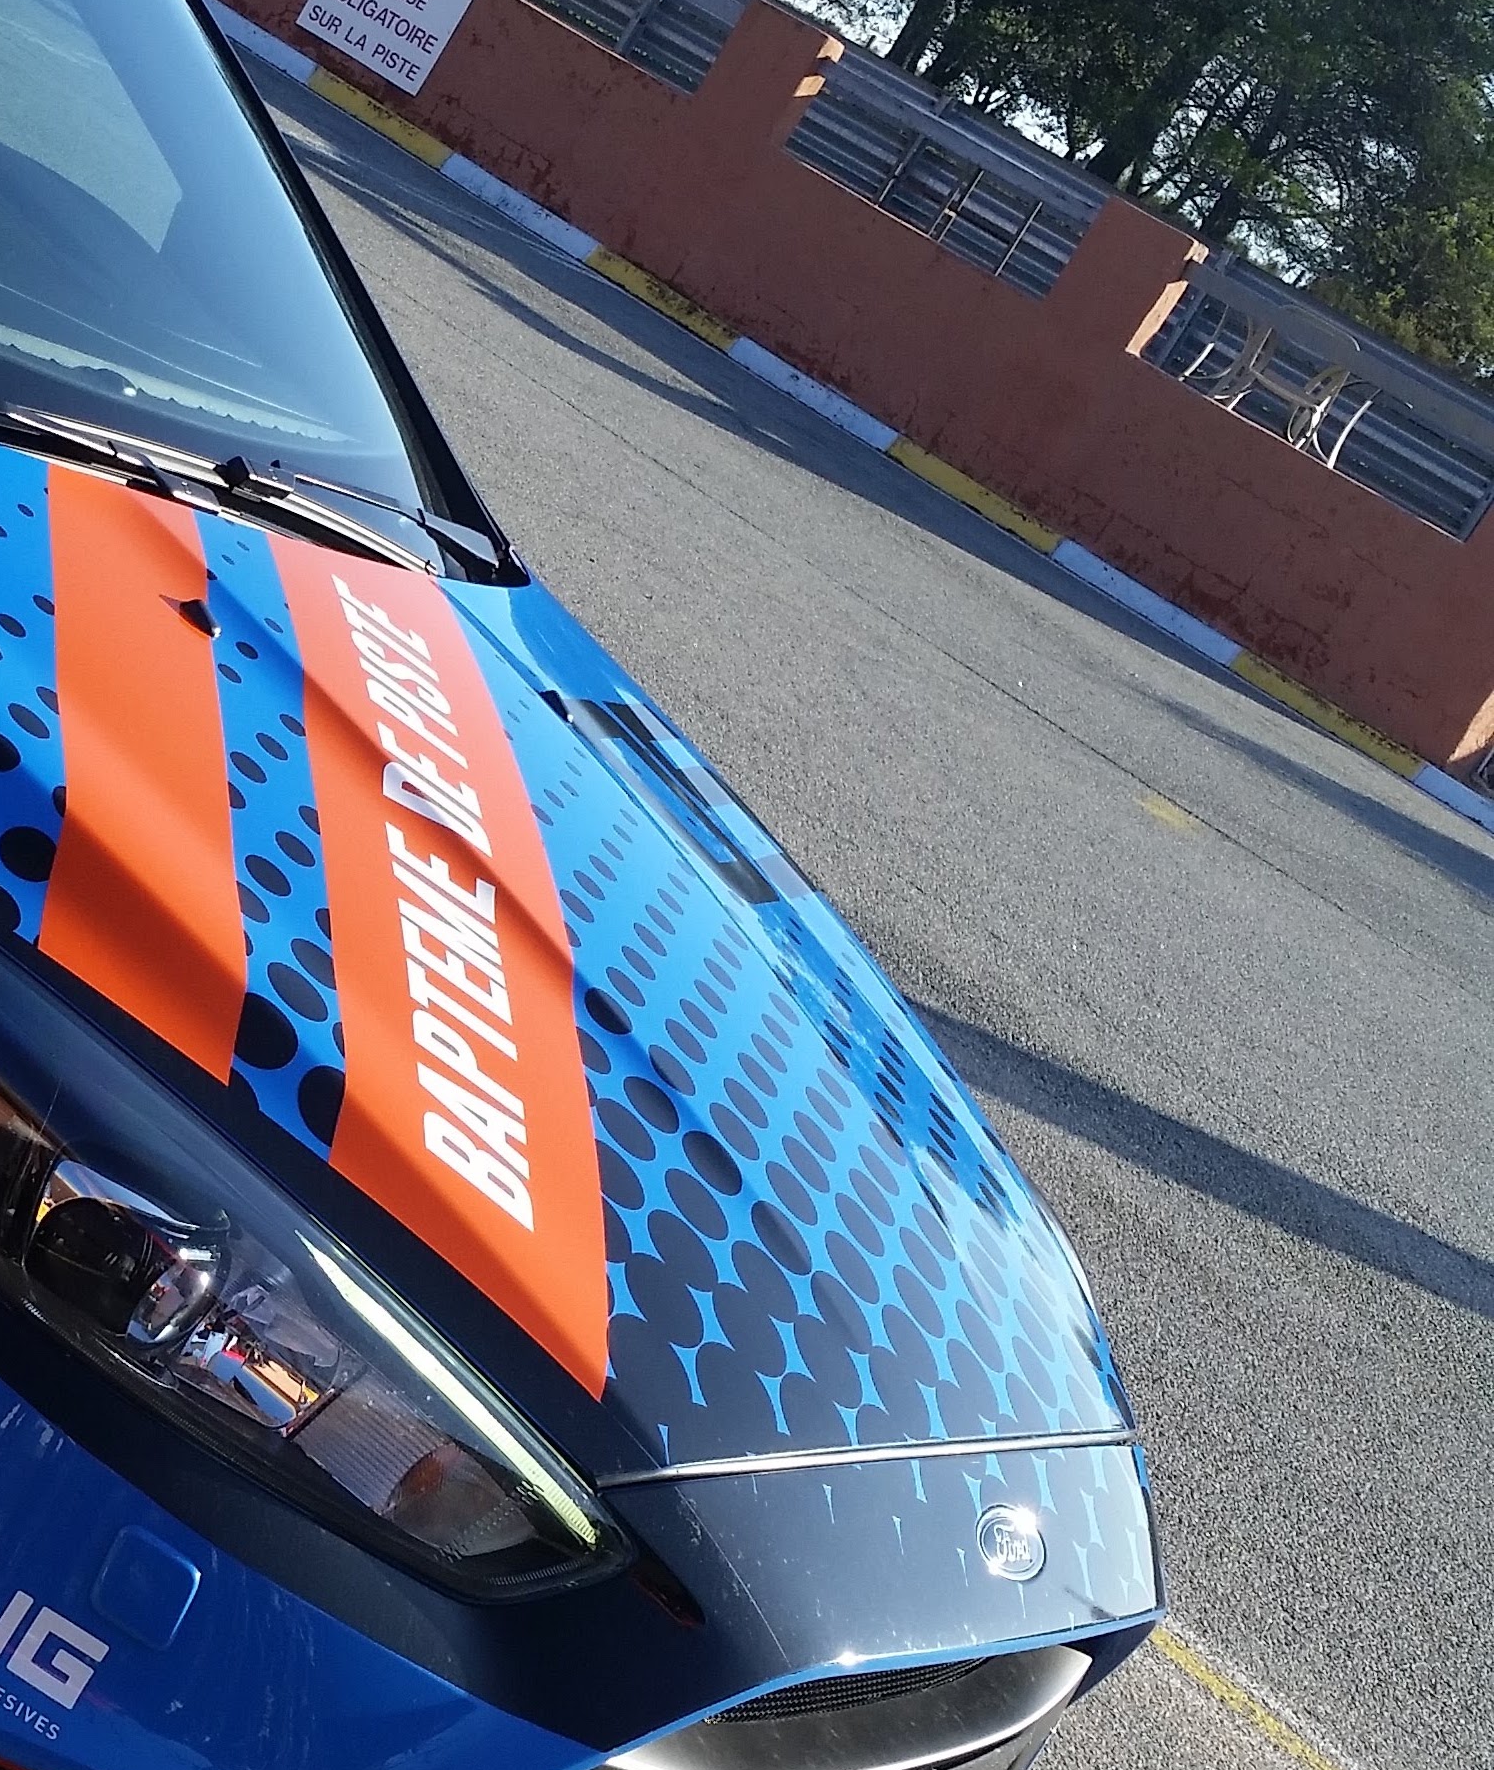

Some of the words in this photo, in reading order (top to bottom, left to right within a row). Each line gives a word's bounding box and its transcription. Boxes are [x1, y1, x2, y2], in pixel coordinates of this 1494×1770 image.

[308, 5, 343, 35] SUR
[344, 26, 368, 52] LA
[371, 43, 421, 82] PISTE
[331, 574, 469, 770] PISTE
[377, 721, 493, 858] DE
[385, 822, 535, 1233] BAPTEME
